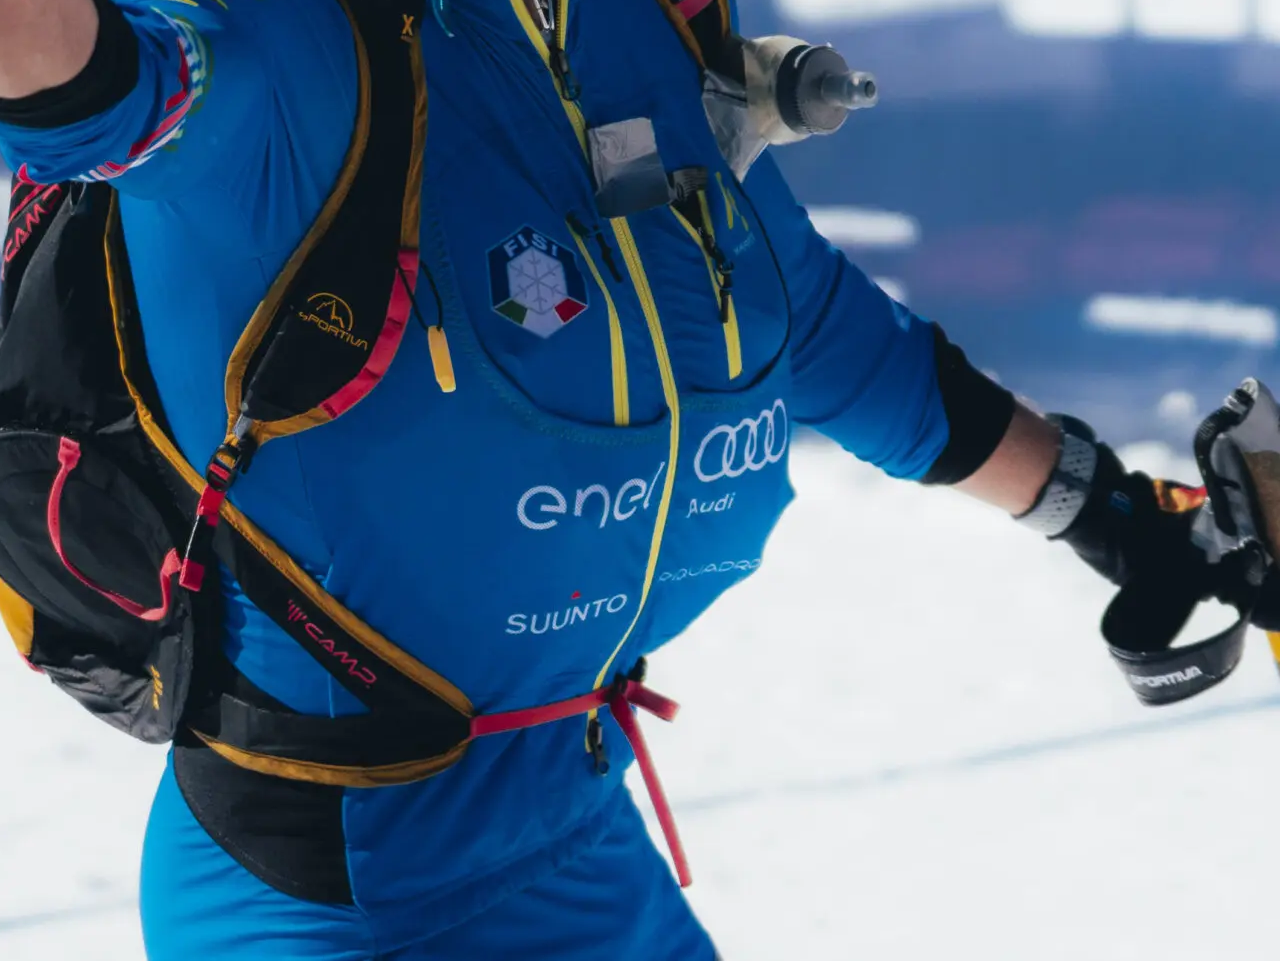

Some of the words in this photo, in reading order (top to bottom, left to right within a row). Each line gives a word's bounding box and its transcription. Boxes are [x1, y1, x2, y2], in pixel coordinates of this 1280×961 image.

[503, 232, 559, 257] FISI
[298, 311, 368, 352] SPORTIVA
[516, 461, 666, 530] enel
[686, 492, 737, 519] Audi
[505, 594, 628, 635] SUUNTO
[304, 621, 378, 687] CAMP
